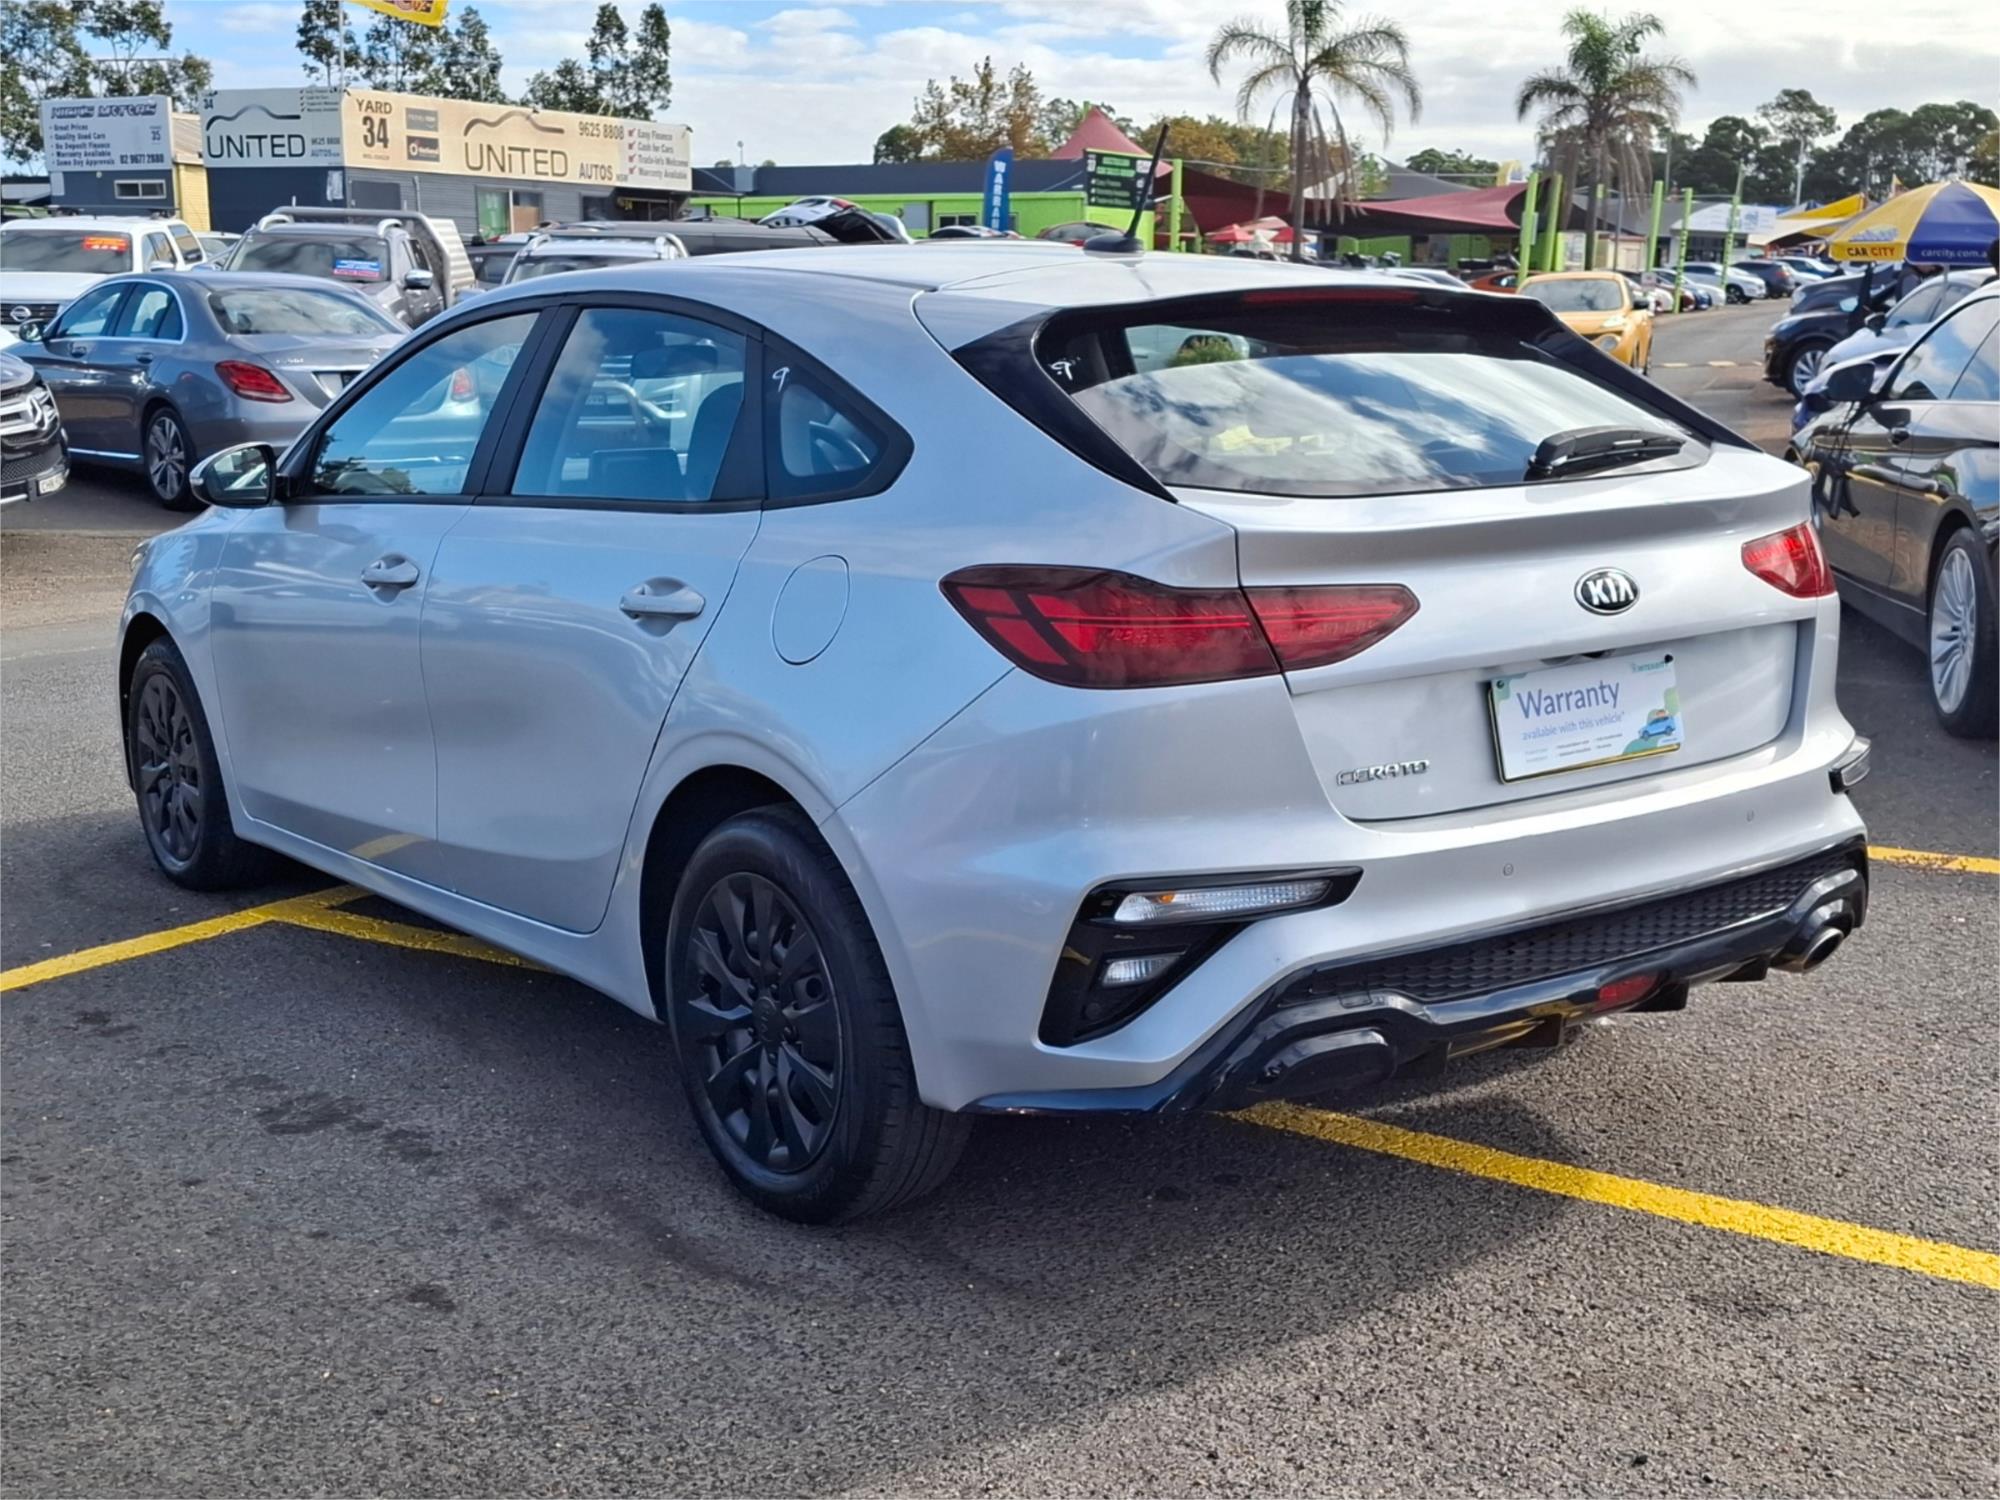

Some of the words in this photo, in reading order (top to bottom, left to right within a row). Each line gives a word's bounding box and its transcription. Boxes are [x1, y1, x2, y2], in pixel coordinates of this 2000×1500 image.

[355, 98, 393, 115] YARD
[362, 115, 390, 149] 34
[578, 121, 601, 138] 9625
[579, 162, 613, 181] AUTOS
[1846, 247, 1869, 257] CAR
[1870, 246, 1896, 256] CITY
[1585, 575, 1635, 605] KIA
[1516, 680, 1620, 720] Warranty
[1522, 726, 1557, 741] available
[1558, 722, 1577, 736] with
[1578, 719, 1594, 734] this
[1336, 759, 1430, 786] CERATO
